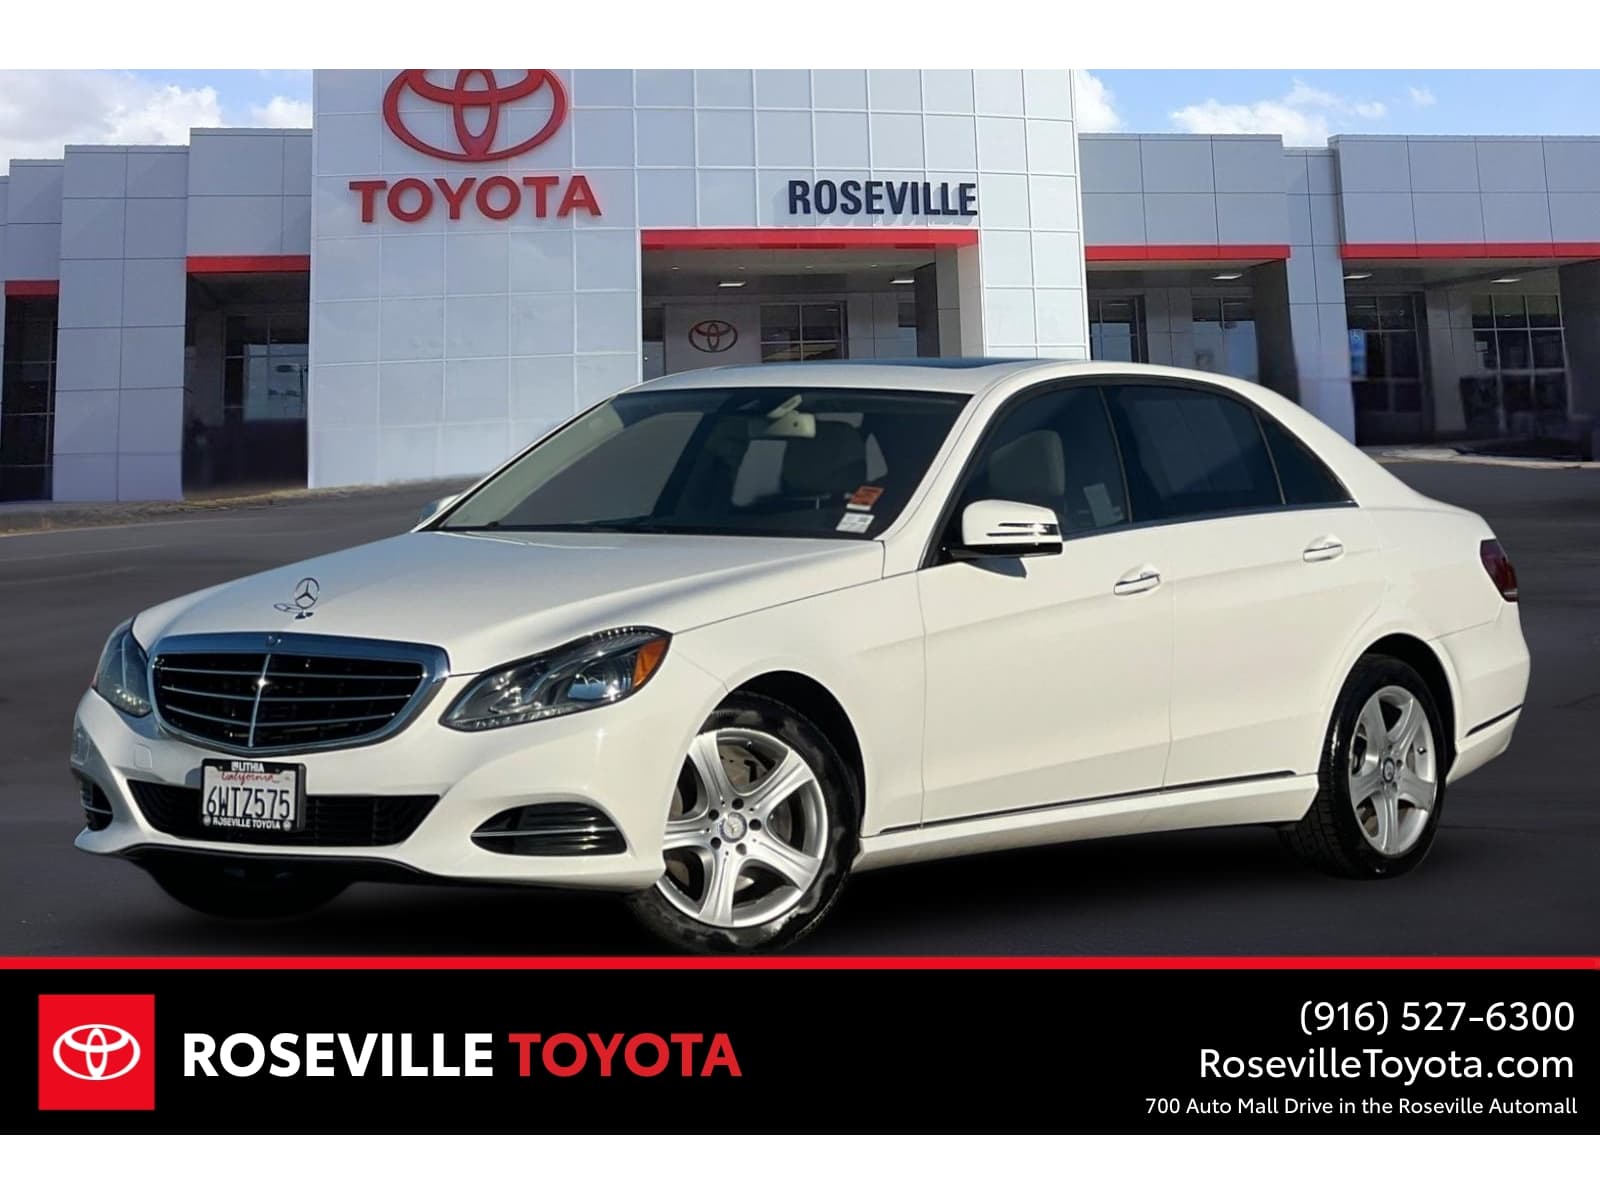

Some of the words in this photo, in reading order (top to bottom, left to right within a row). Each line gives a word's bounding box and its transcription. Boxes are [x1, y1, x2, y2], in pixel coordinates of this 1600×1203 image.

[349, 175, 602, 224] TOYOTA
[788, 180, 978, 216] ROSEVILLE
[239, 762, 265, 773] LITHIA
[206, 785, 290, 819] 6WTZ575
[212, 817, 251, 828] ROSEVILLE
[252, 819, 281, 830] TOYOTA
